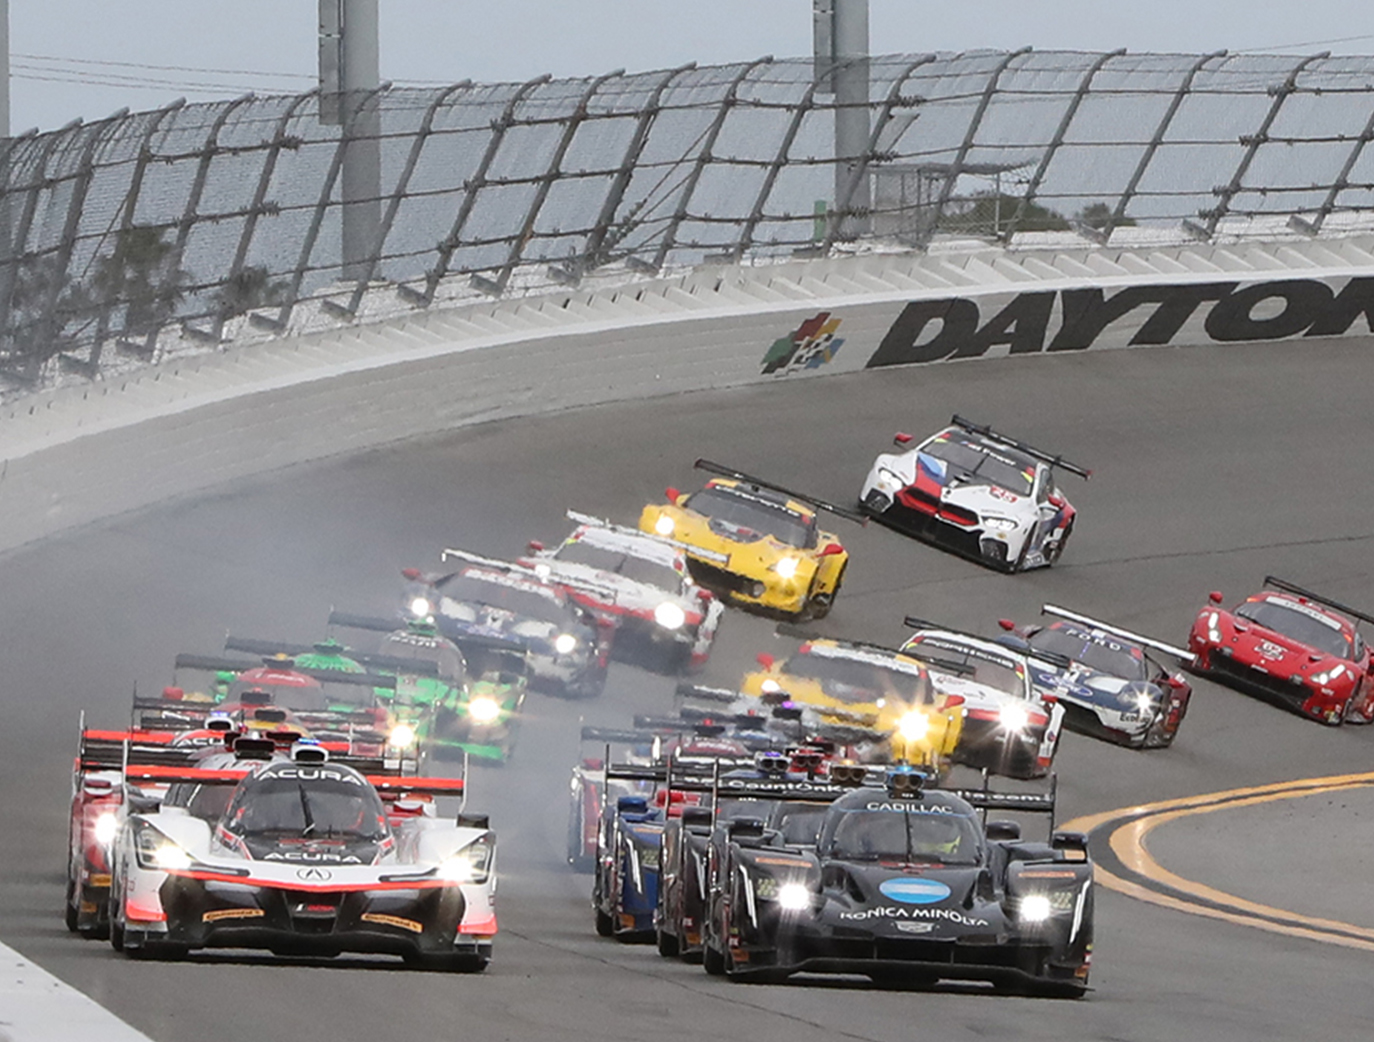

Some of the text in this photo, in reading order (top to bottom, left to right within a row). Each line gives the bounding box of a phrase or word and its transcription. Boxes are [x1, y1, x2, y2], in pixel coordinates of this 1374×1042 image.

[1065, 628, 1122, 651] FORD
[257, 768, 362, 786] ACURA
[866, 802, 954, 814] CADILLAC
[263, 851, 362, 864] ACURA
[840, 907, 989, 927] KONICA MINOLTA
